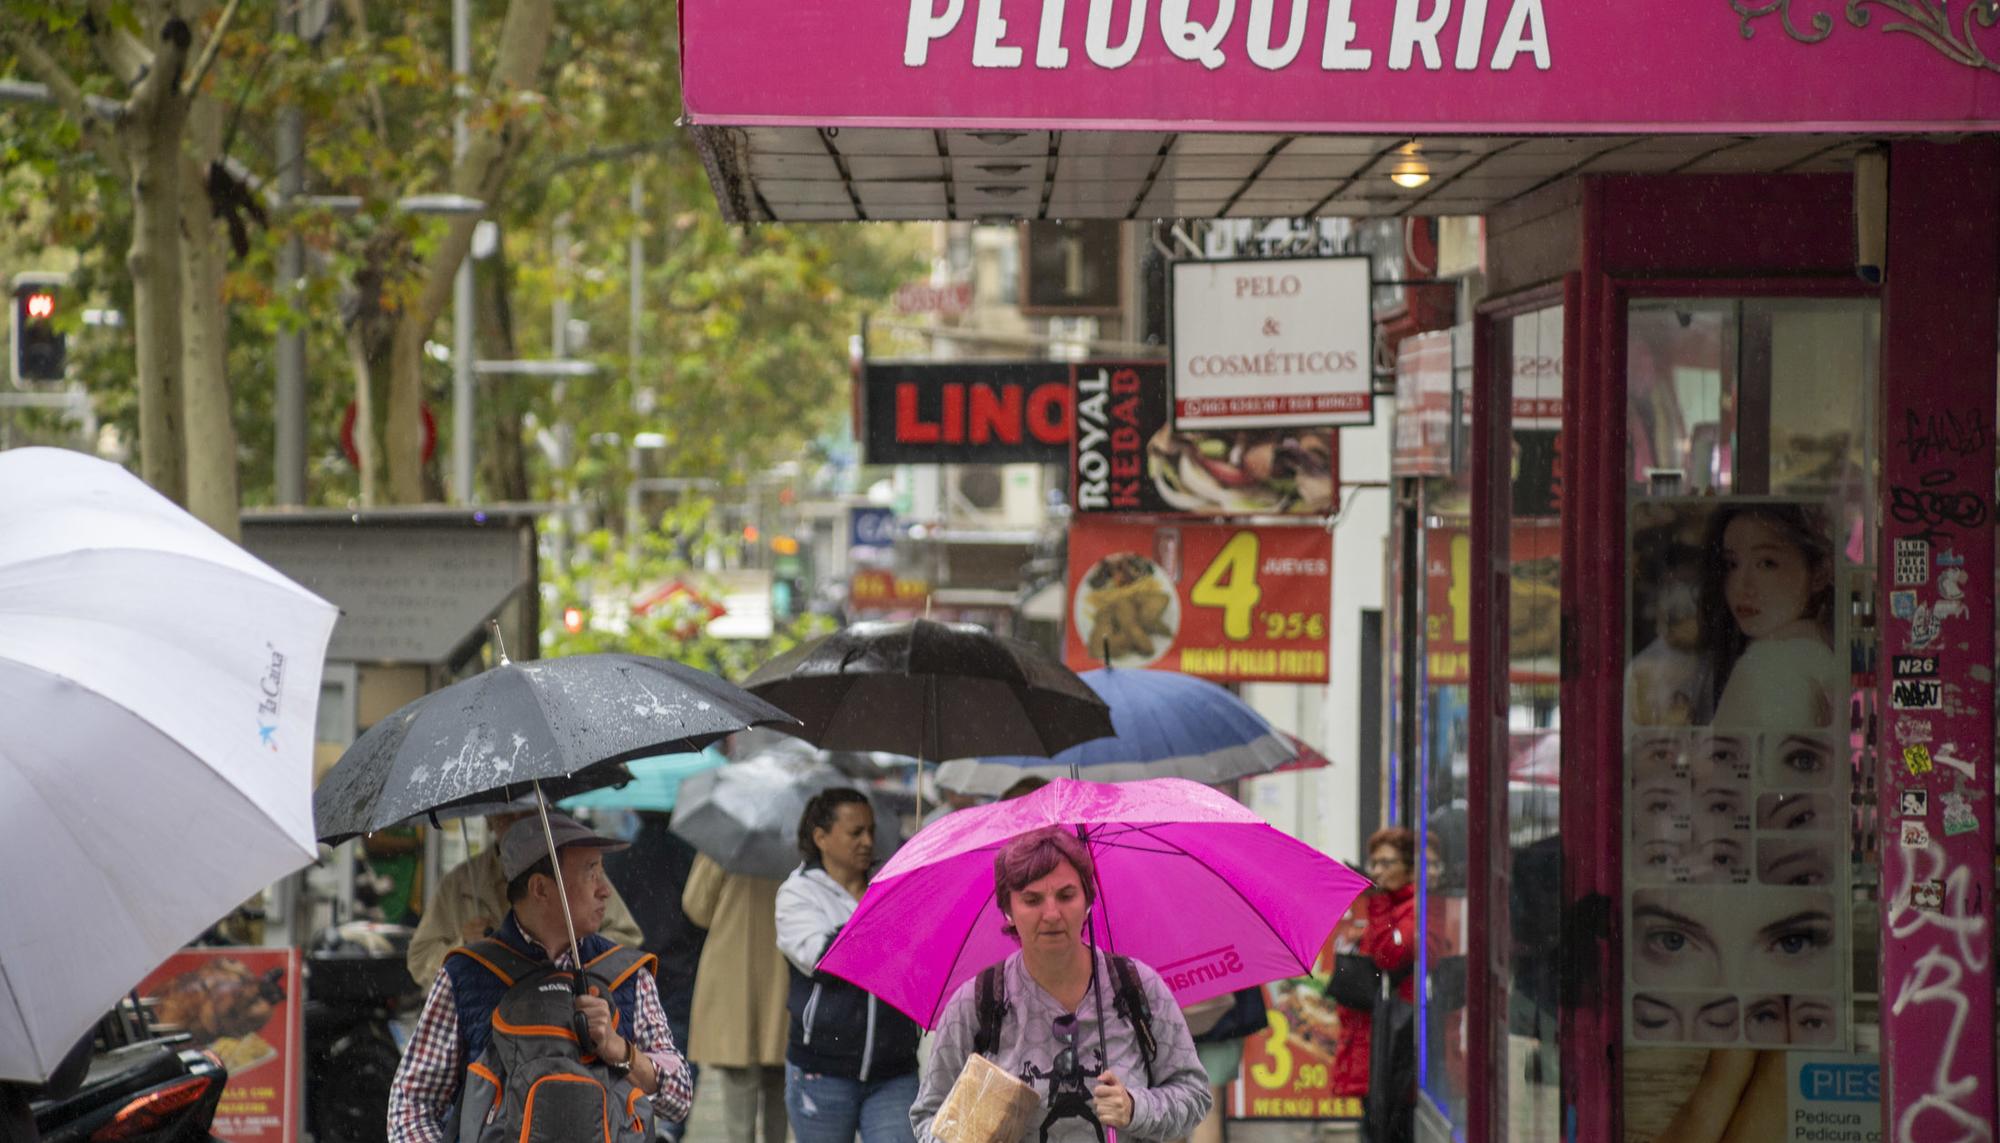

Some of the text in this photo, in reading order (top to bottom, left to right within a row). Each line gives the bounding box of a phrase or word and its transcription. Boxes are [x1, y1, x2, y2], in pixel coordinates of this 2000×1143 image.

[1234, 275, 1302, 298] PELO
[1262, 316, 1281, 337] &
[1188, 348, 1358, 378] COSMÉTICOS
[1078, 367, 1110, 511] ROYAL
[1110, 367, 1141, 507] KEBAB
[1262, 558, 1327, 576] JUEVES
[1191, 530, 1261, 641] 4
[1898, 658, 1934, 674] N26
[1251, 1009, 1293, 1089] 3
[1812, 1071, 1880, 1097] PIES
[1795, 1109, 1861, 1126] Pedicura
[1795, 1127, 1861, 1142] Pedicura
